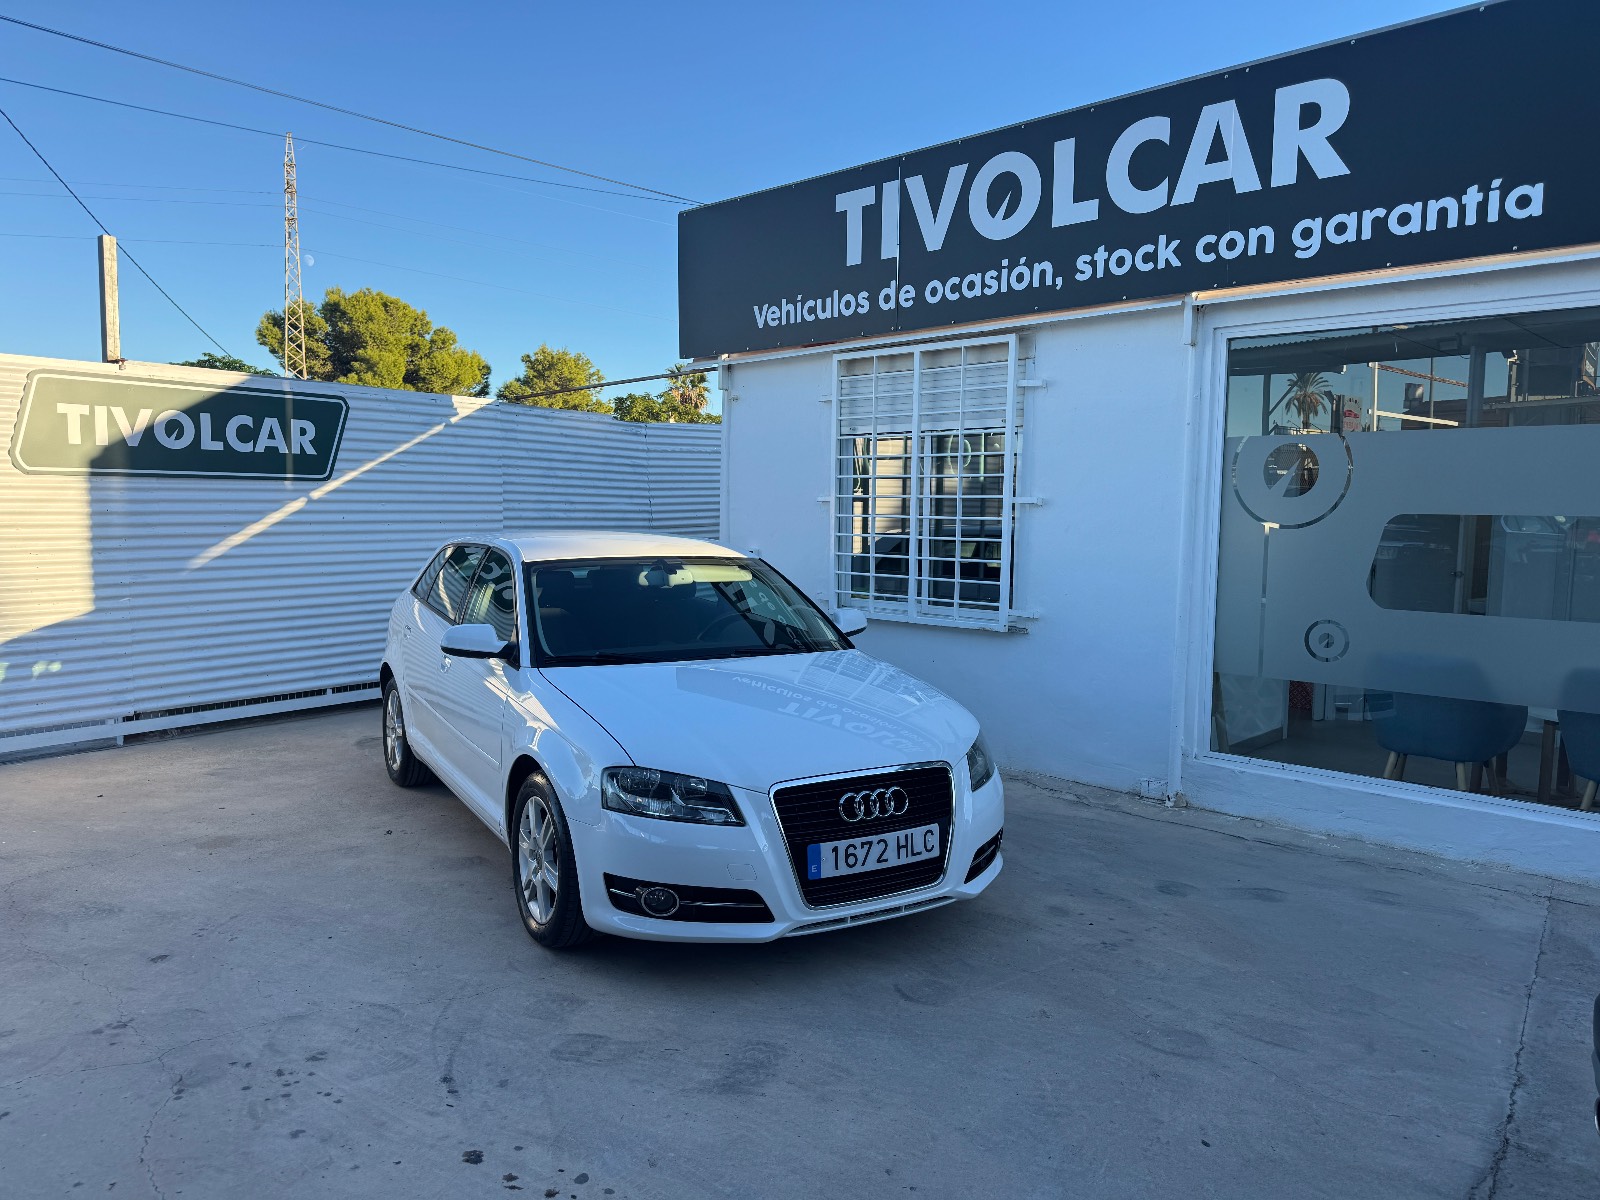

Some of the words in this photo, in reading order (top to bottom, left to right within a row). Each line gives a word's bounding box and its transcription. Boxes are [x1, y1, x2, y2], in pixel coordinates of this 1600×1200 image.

[835, 78, 1352, 267] TIVOLCAR
[753, 290, 870, 329] Vehículos
[878, 280, 916, 310] de
[924, 257, 1062, 304] ocasión,
[1074, 235, 1182, 282] stock
[1195, 226, 1275, 263] con
[1292, 178, 1545, 259] garantía
[57, 403, 318, 455] TIVOLCAR
[811, 864, 818, 874] E
[830, 840, 890, 872] 1672
[896, 829, 935, 860] HLC
